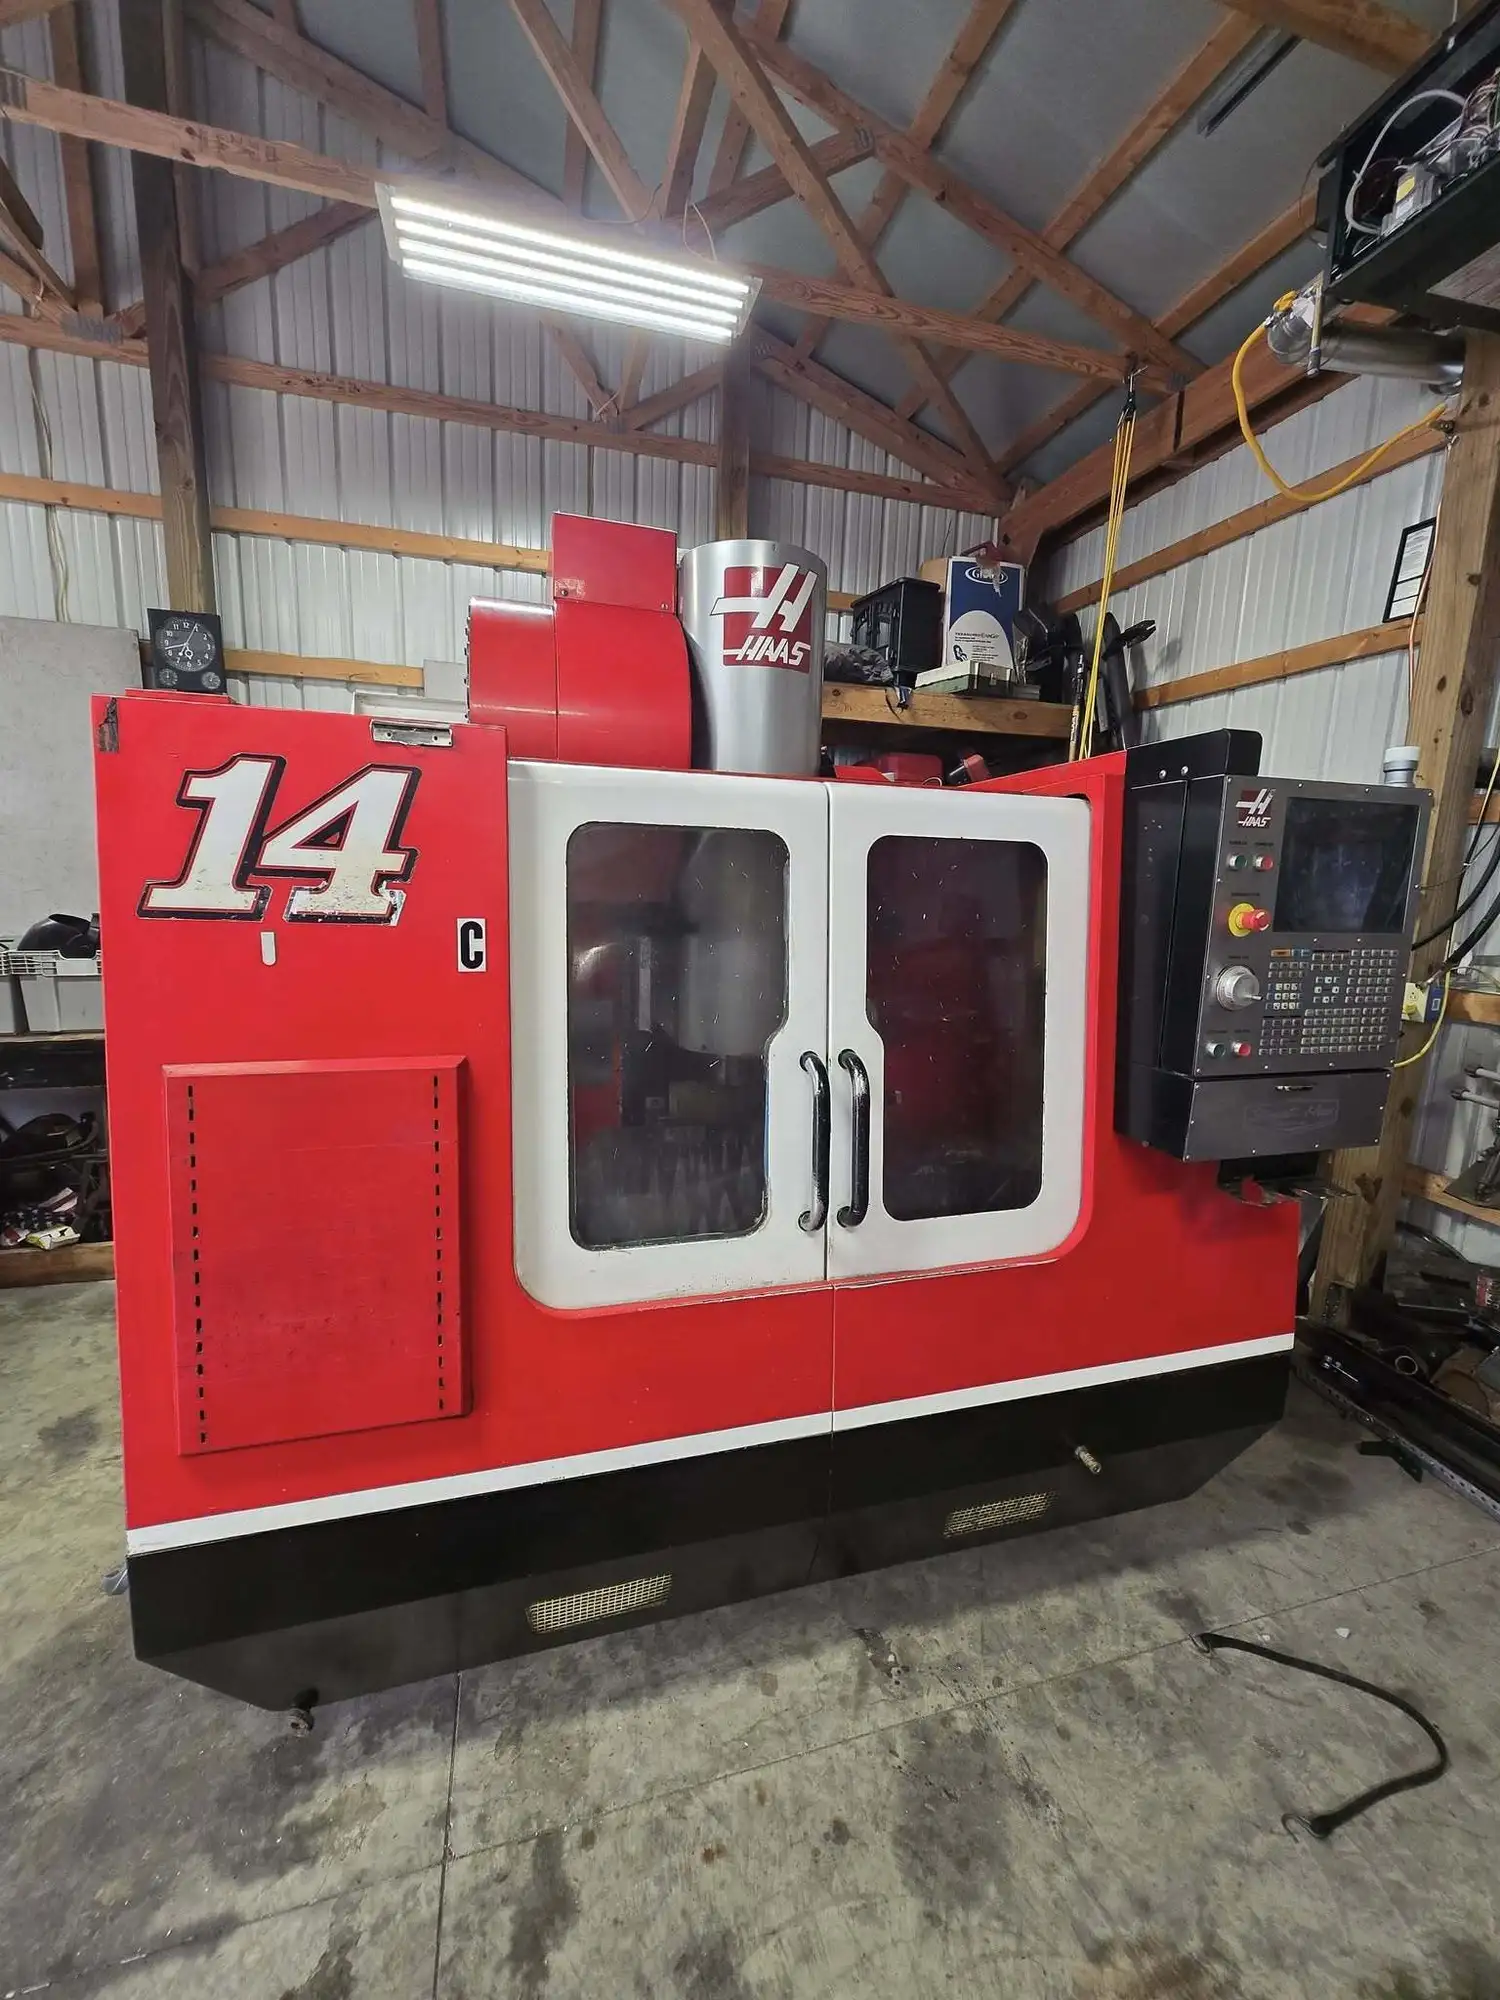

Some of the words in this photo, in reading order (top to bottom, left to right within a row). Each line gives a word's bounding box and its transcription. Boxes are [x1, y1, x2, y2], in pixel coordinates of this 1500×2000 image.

[182, 621, 190, 629] 12
[203, 633, 208, 641] 2
[723, 635, 811, 666] HAAS
[1238, 816, 1272, 827] HAAS
[136, 752, 422, 926] 14
[460, 921, 484, 970] C
